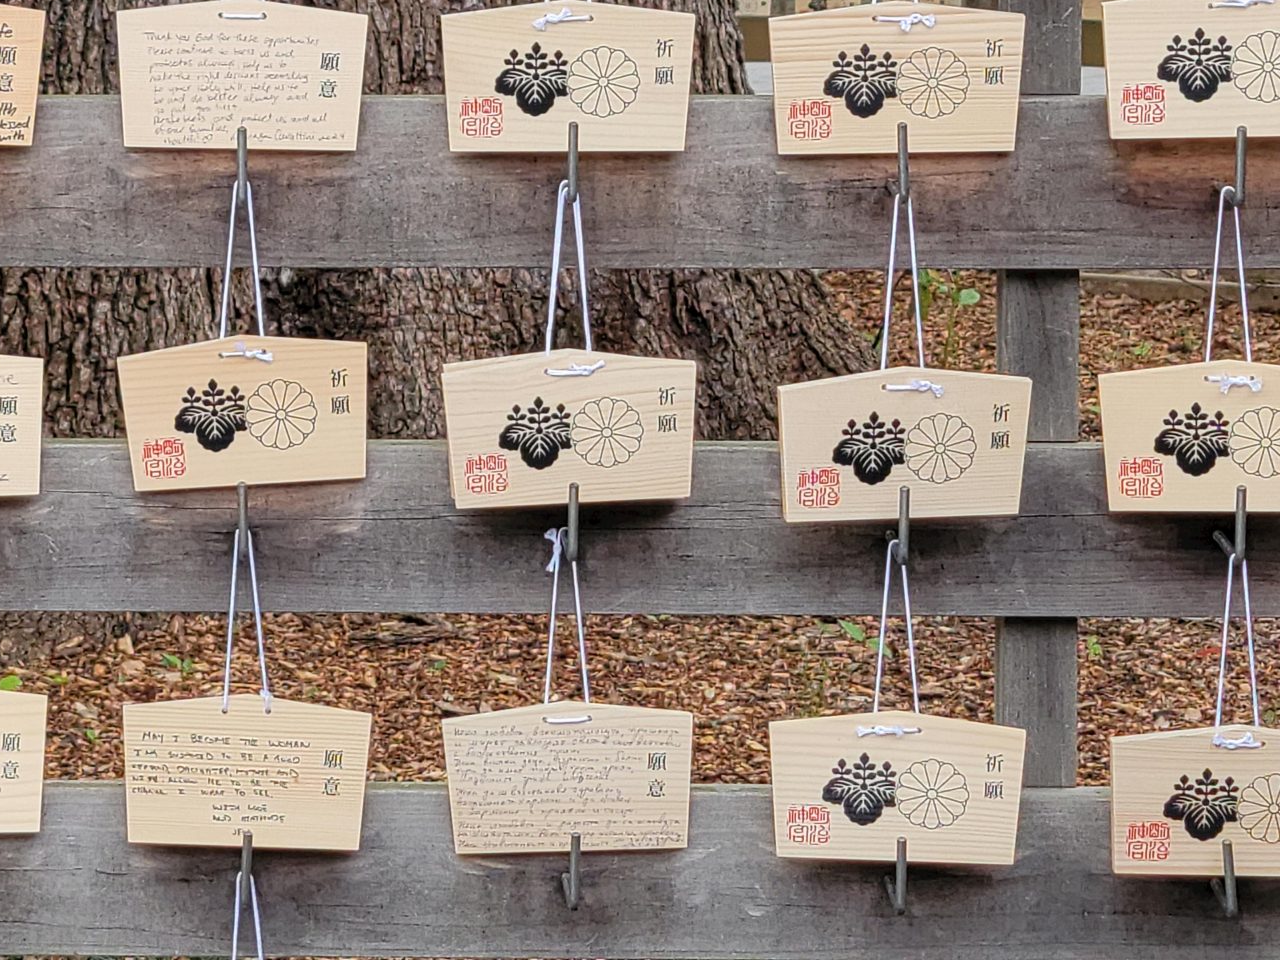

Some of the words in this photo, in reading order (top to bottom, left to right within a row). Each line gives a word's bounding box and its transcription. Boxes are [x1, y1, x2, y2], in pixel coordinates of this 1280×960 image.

[318, 52, 341, 98] 願意
[654, 38, 674, 85] 祈願
[985, 39, 1004, 85] 祈願
[0, 133, 25, 141] with
[330, 368, 351, 415] 祈願
[658, 387, 677, 435] 祈願
[990, 403, 1010, 450] 祈願
[0, 733, 21, 780] 願意
[142, 732, 163, 743] MAY
[191, 734, 231, 745] BECOME
[269, 740, 311, 749] WOMAN
[321, 749, 344, 797] 願意
[646, 752, 667, 798] 願意
[984, 753, 1004, 800] 祈願
